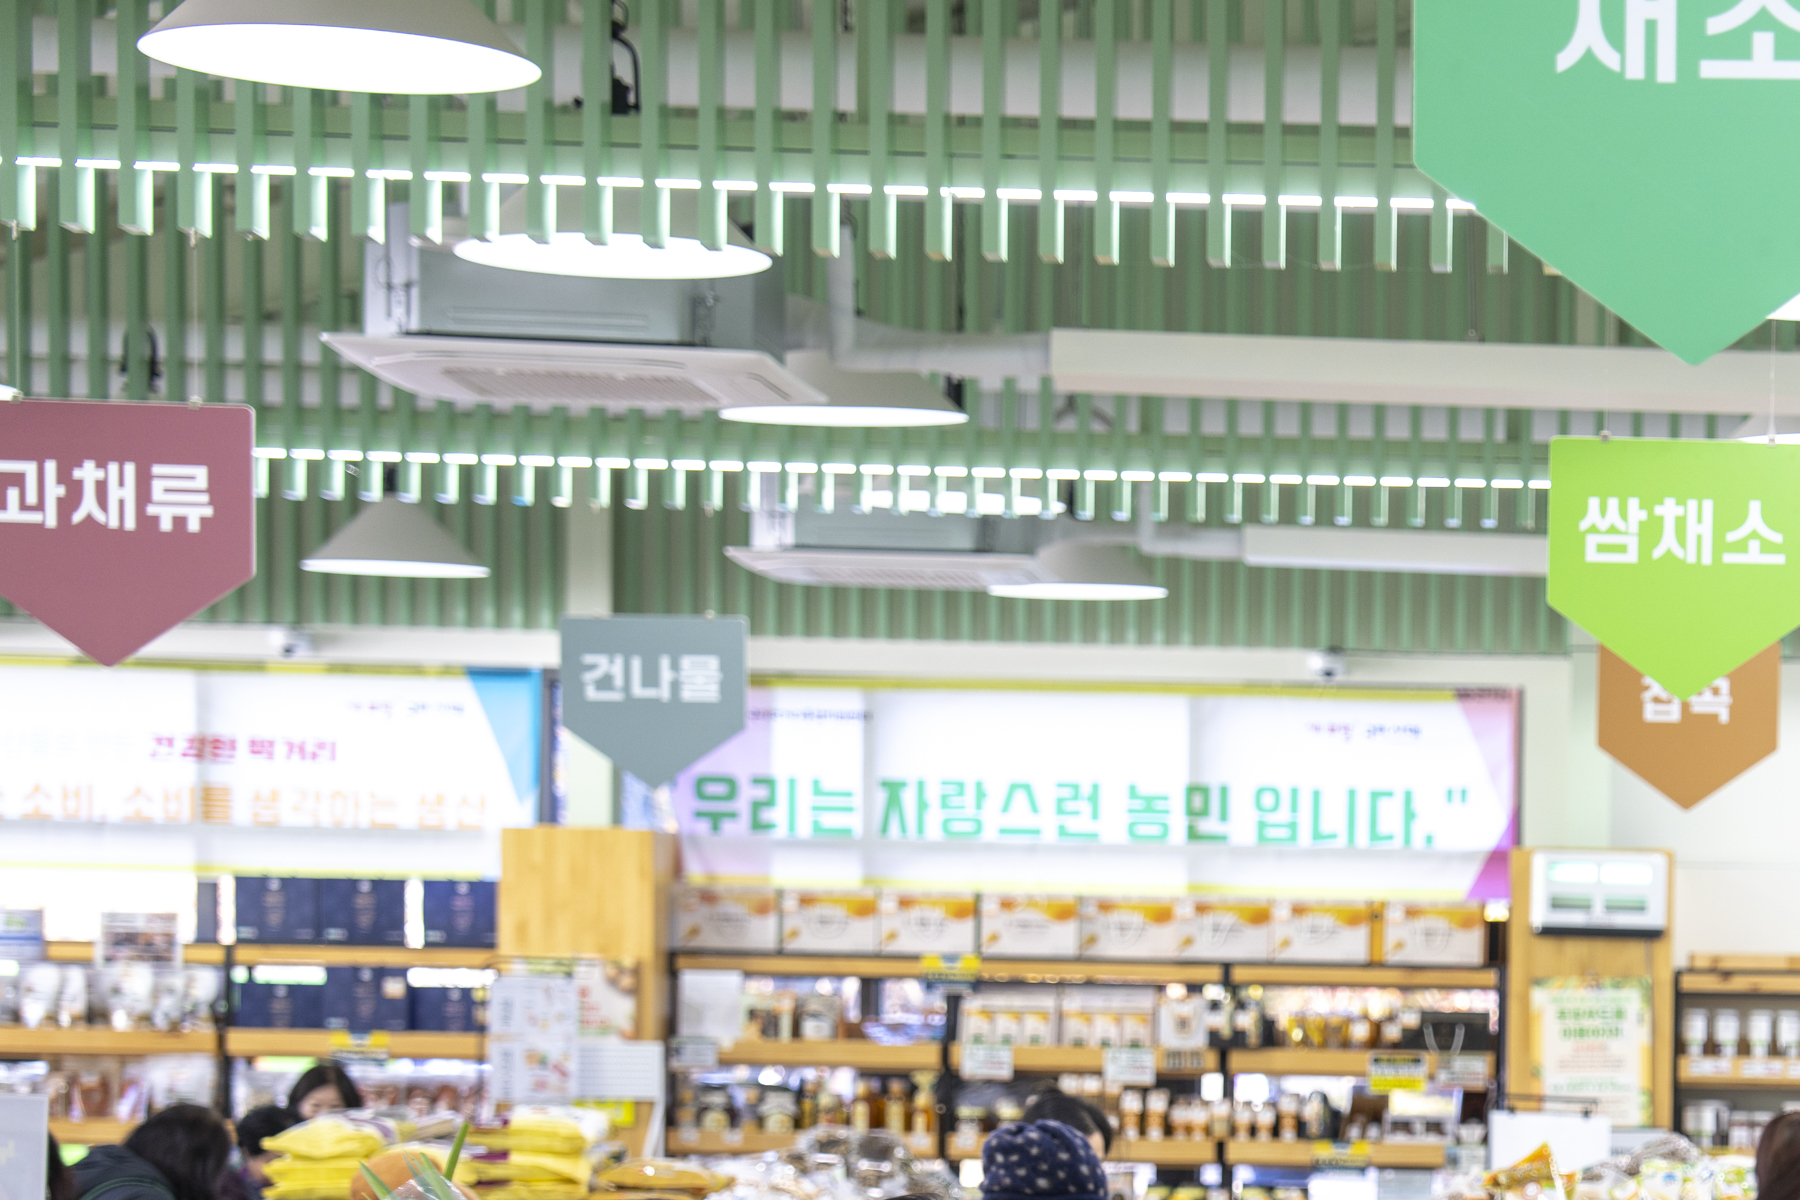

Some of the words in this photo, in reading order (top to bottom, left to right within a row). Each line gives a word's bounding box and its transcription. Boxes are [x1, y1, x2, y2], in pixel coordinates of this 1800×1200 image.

[0, 460, 214, 532] 과채류
[1578, 496, 1787, 566] 쌈채소
[579, 654, 723, 704] 건나물
[693, 774, 855, 839] 우리는
[880, 779, 1102, 841] 자랑스런
[1129, 784, 1230, 843] 농민
